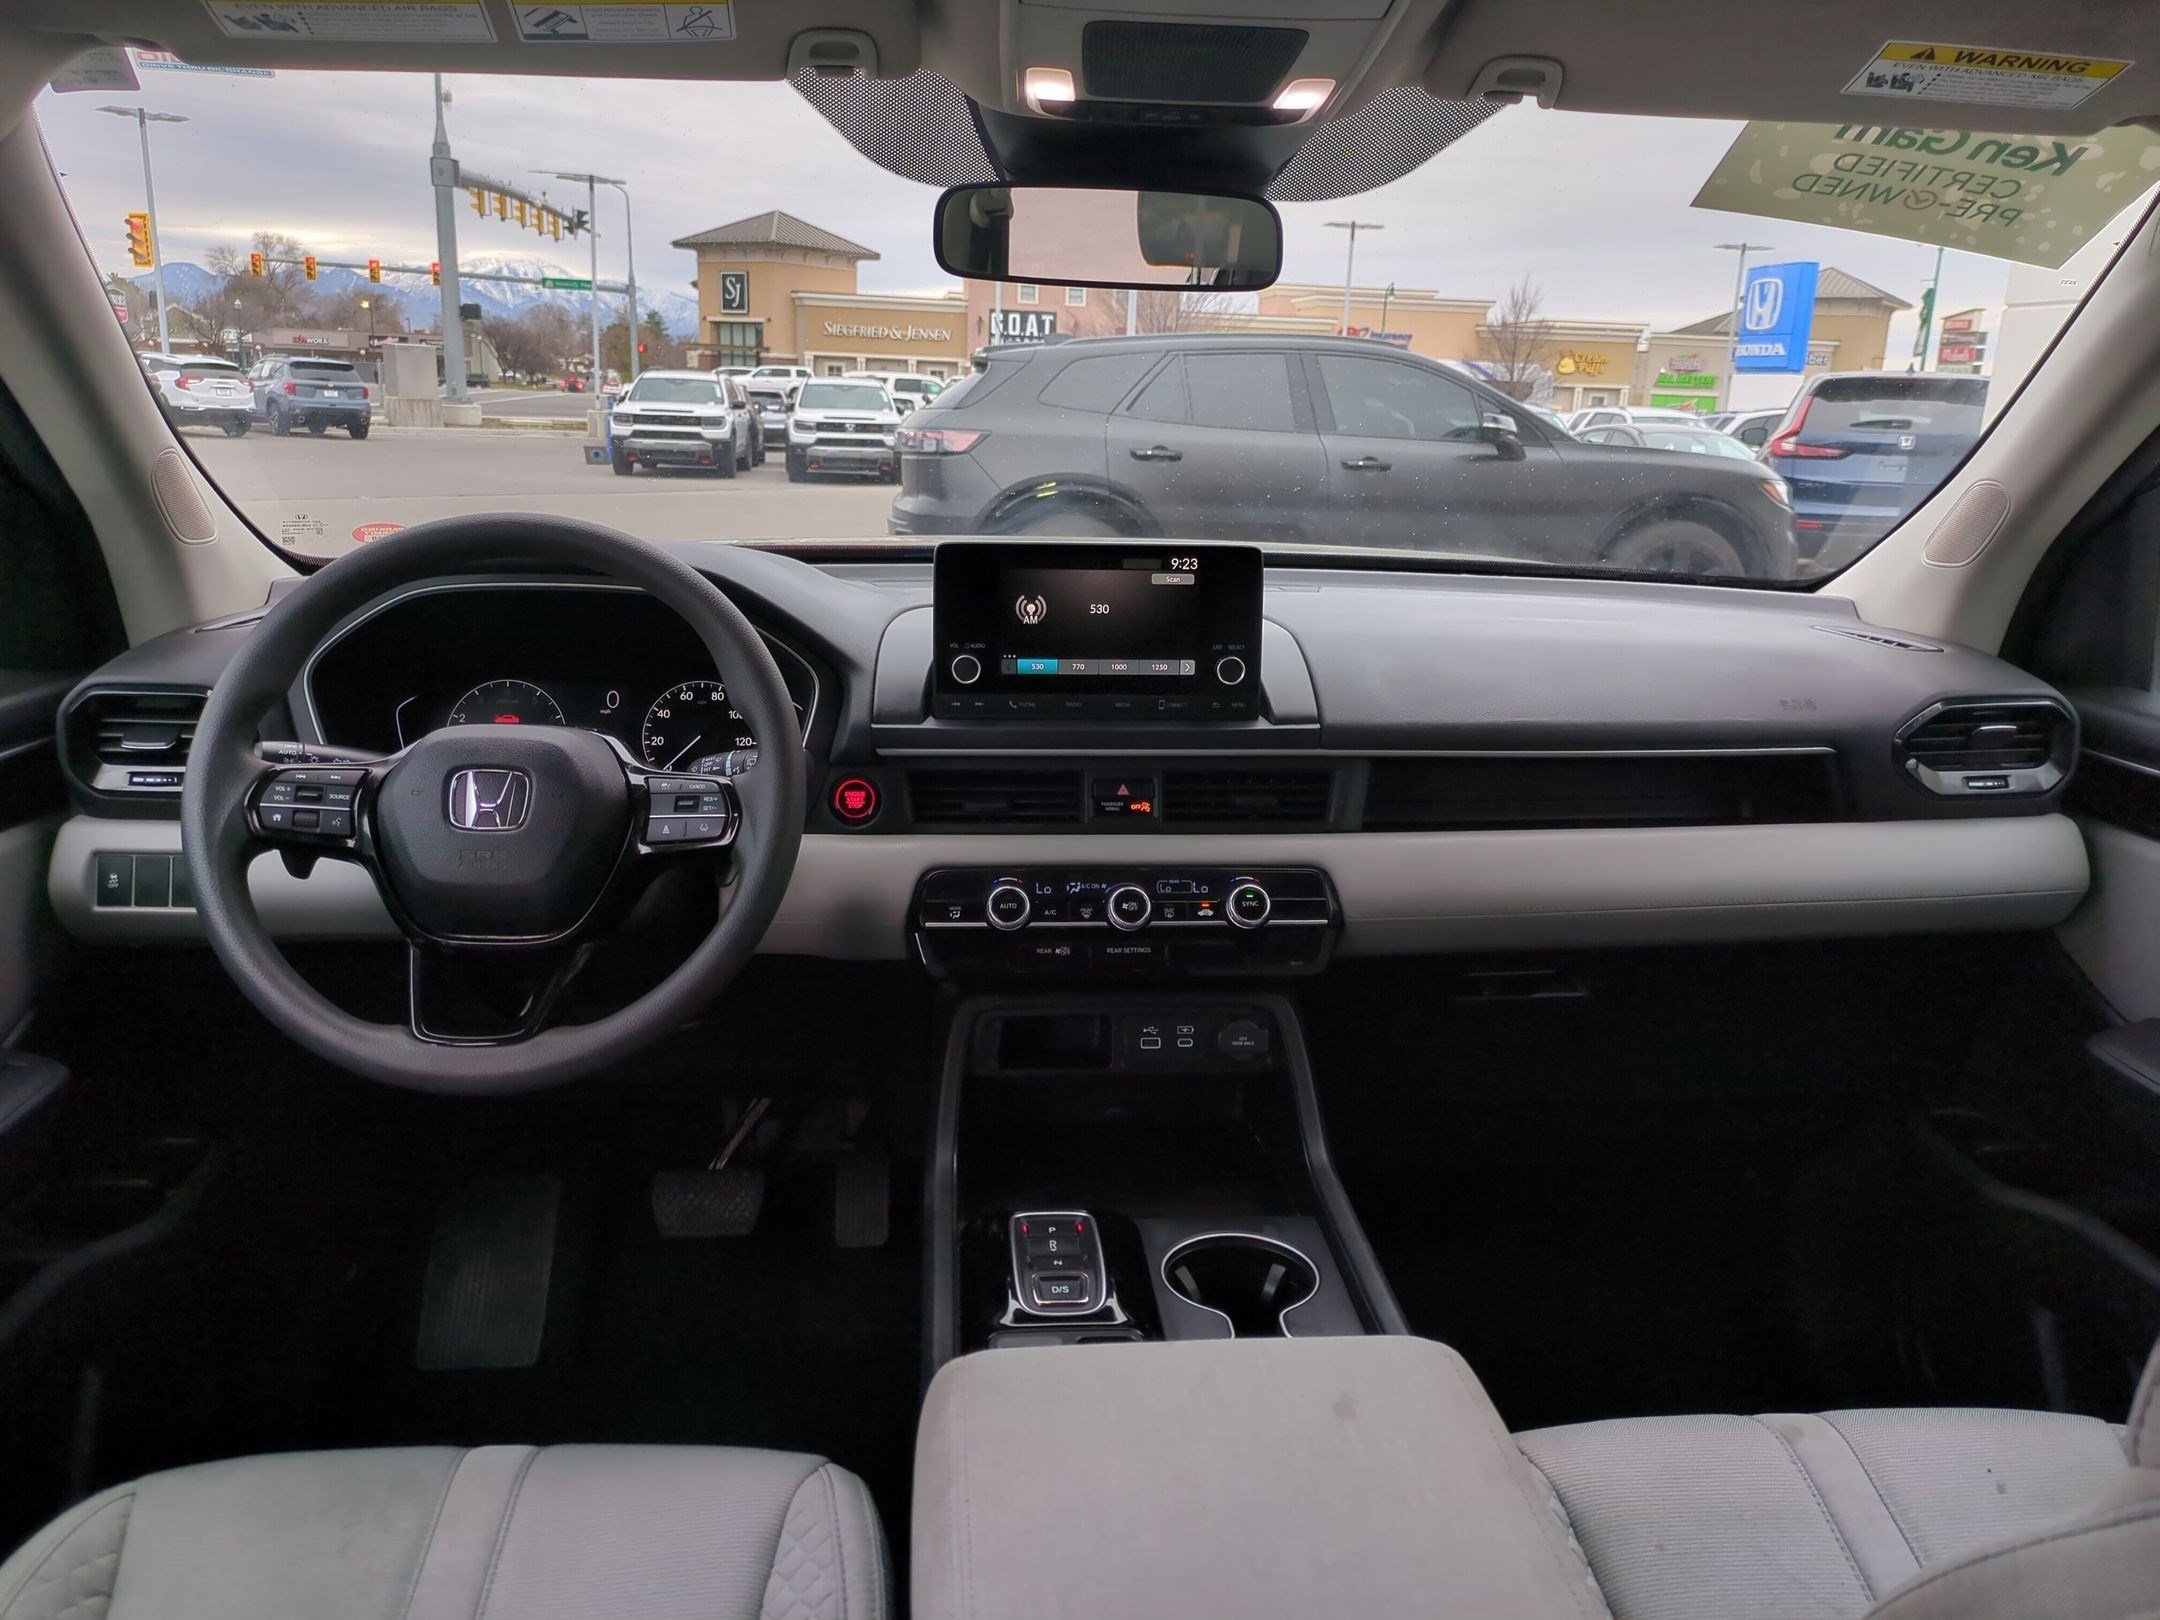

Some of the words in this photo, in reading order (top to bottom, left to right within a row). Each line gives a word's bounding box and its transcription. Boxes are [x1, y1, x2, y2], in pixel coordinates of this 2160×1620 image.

[1953, 51, 2091, 74] WARNING
[824, 320, 889, 339] SIEGFRIED
[889, 326, 903, 340] &
[904, 325, 953, 342] JENSEN
[1171, 558, 1199, 570] 9:23
[1165, 575, 1182, 583] Scan
[1090, 604, 1110, 614] 530
[1023, 615, 1039, 624] AM
[1031, 663, 1045, 671] 530
[1072, 663, 1085, 671] 770
[1111, 663, 1128, 671] 1000
[1151, 663, 1168, 671] 1250
[606, 690, 620, 709] 0
[680, 691, 694, 701] 60
[711, 691, 725, 701] 80
[459, 713, 466, 723] 2
[657, 709, 671, 719] 40
[650, 736, 665, 746] 20
[735, 737, 752, 747] 120
[999, 902, 1018, 910] AUTO
[1044, 908, 1057, 916] A/C
[1048, 1226, 1056, 1234] P
[1051, 1285, 1070, 1294] D/S
